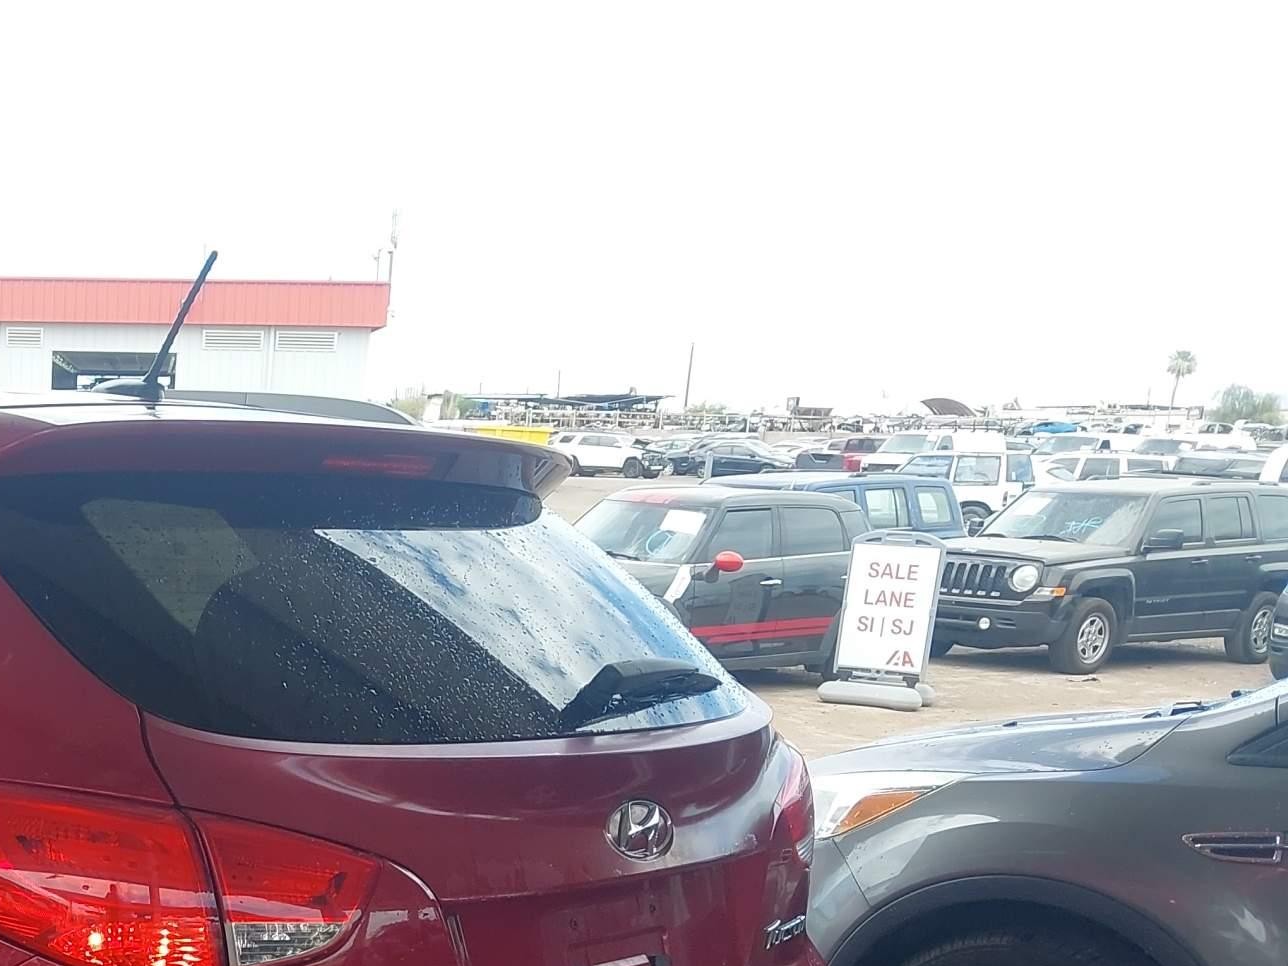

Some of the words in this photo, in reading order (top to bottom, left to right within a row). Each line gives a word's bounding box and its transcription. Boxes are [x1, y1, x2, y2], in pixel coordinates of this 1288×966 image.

[868, 562, 920, 581] SALE
[864, 589, 916, 608] LANE
[857, 616, 874, 632] SI
[890, 619, 914, 636] SJ
